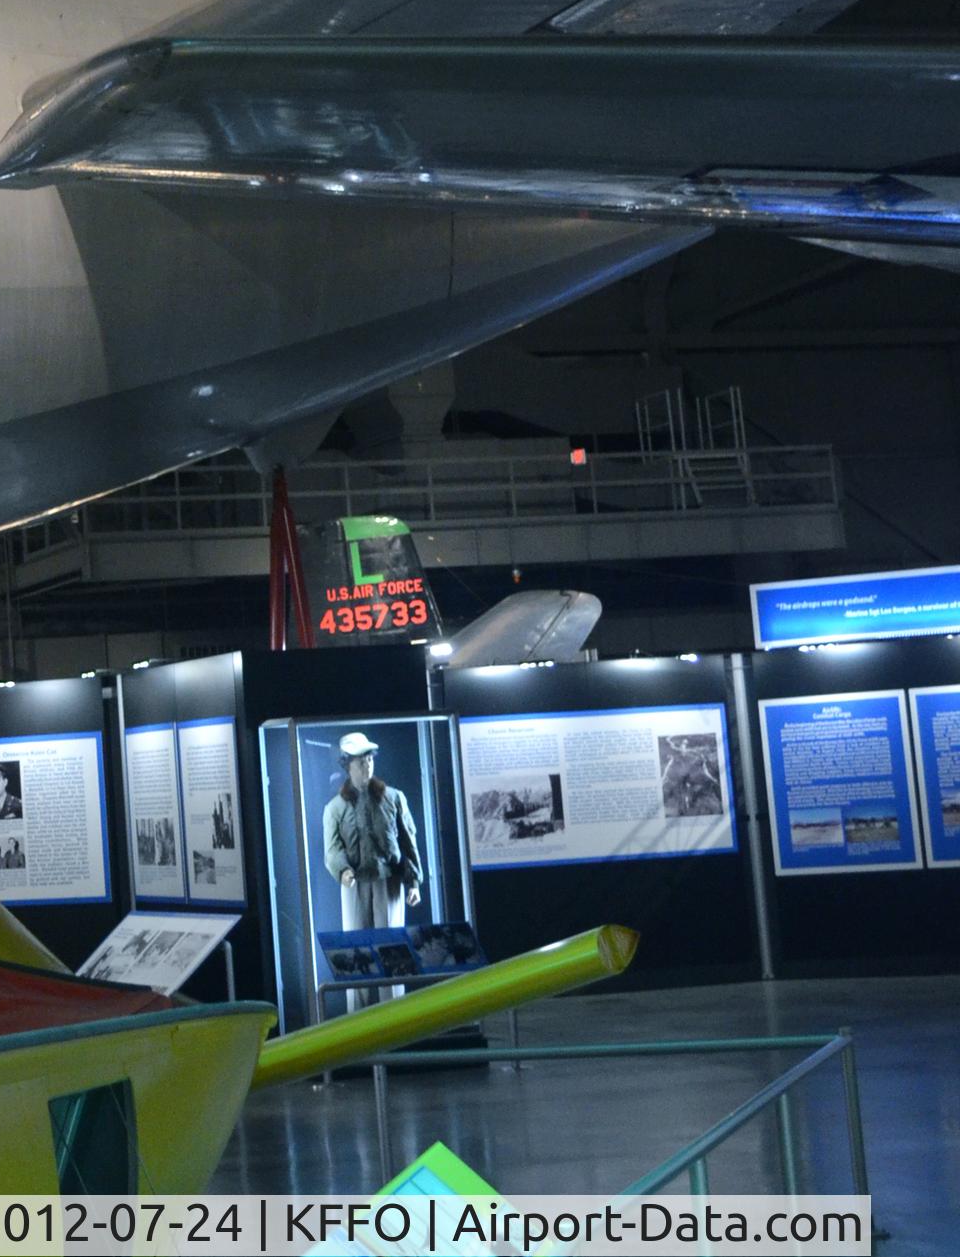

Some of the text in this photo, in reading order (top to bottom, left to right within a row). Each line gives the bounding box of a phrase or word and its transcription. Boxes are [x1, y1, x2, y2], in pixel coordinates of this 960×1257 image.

[349, 541, 385, 585] L
[378, 578, 423, 596] FORCE
[319, 599, 428, 634] 435733
